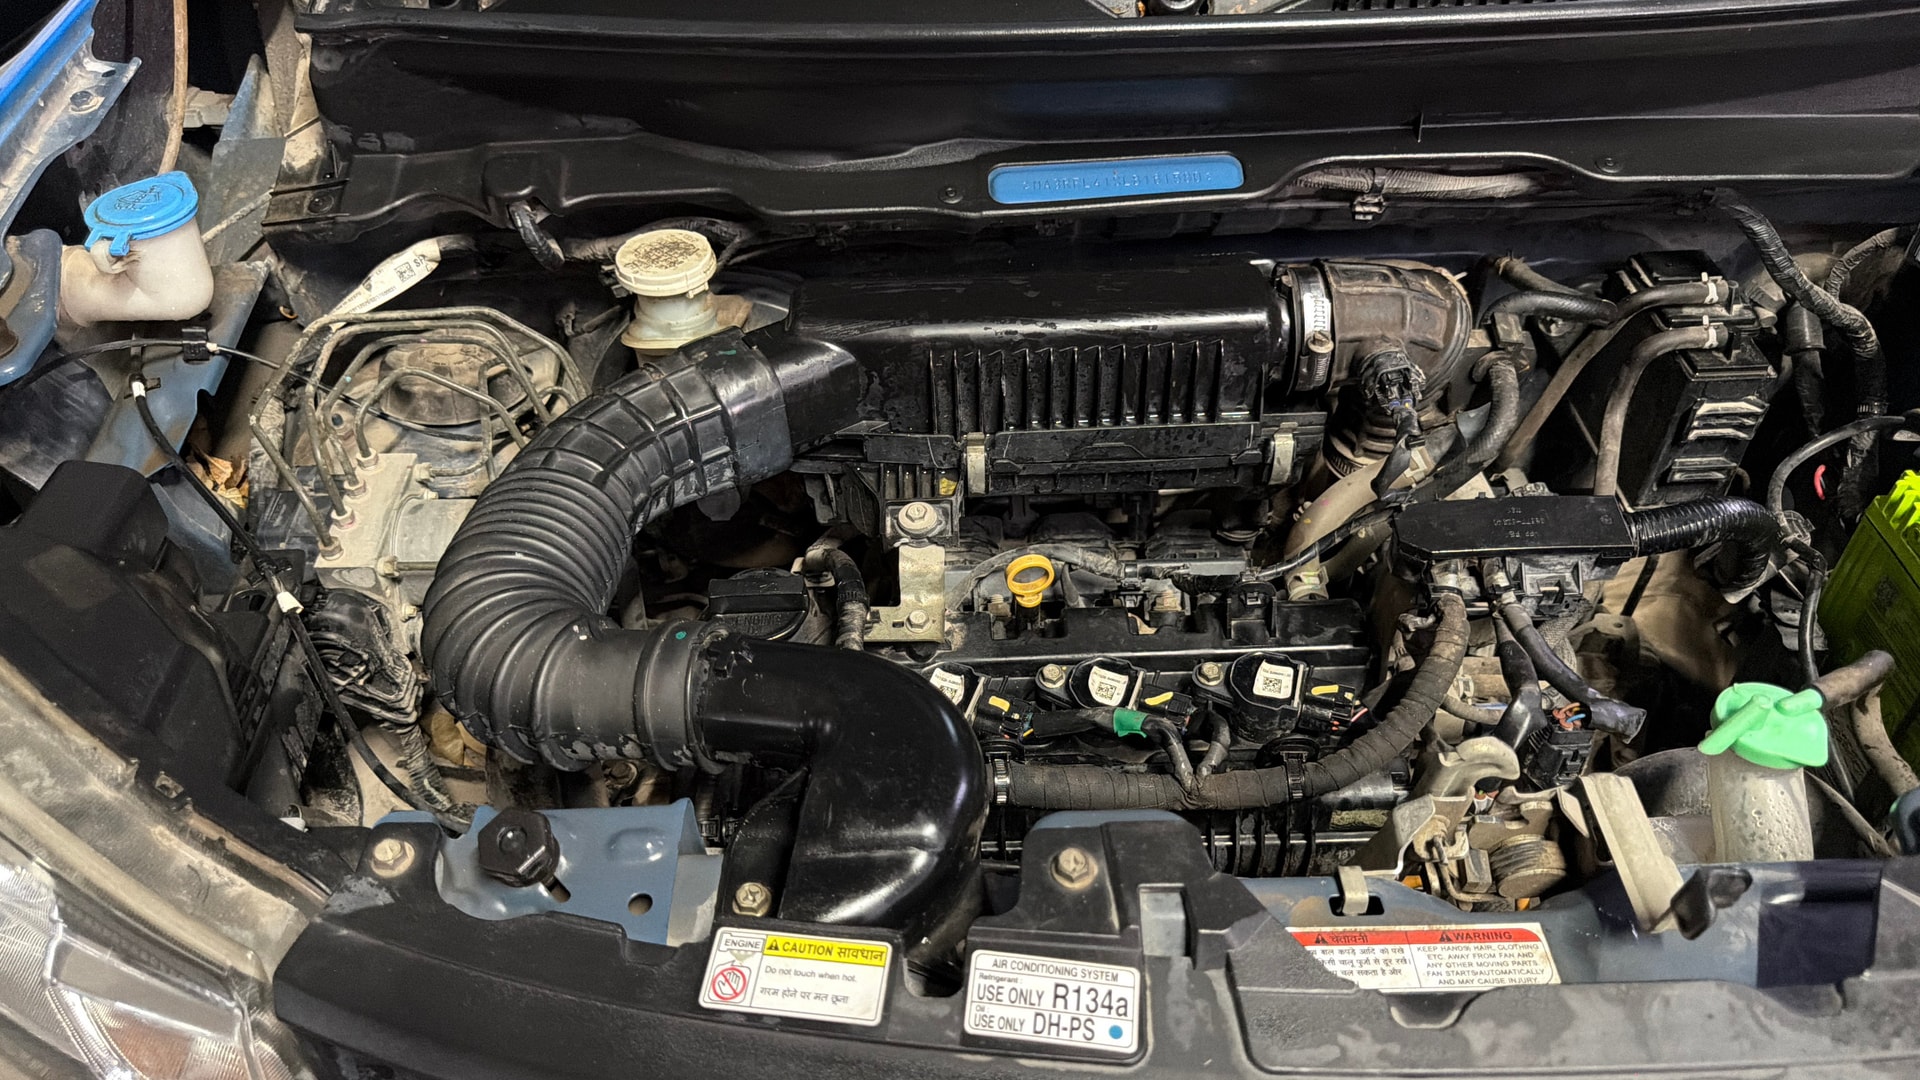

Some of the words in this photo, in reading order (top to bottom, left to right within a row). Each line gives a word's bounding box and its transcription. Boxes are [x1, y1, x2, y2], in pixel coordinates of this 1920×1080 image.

[1453, 931, 1512, 941] WARNING
[724, 939, 760, 949] ENGINE
[782, 942, 833, 956] CAUTION
[1497, 943, 1539, 951] CLOTHING
[837, 946, 885, 961] सावधान
[1473, 952, 1496, 960] FROM
[1518, 951, 1535, 959] AND
[1476, 960, 1509, 968] MOVING
[765, 965, 777, 974] Do
[778, 968, 792, 976] not
[793, 969, 816, 978] touch
[818, 971, 840, 980] when
[992, 958, 1008, 970] AIR
[1010, 960, 1078, 978] CONDITIONING
[1080, 968, 1119, 983] SYSTEM
[979, 972, 1019, 984] Refrigerant
[1477, 977, 1506, 985] CAUSE
[977, 983, 1005, 1003] USE
[1008, 986, 1045, 1007] ONLY
[1052, 982, 1129, 1018] R134a
[975, 1004, 986, 1013] Oil
[974, 1013, 996, 1029] USE
[997, 1016, 1026, 1032] ONLY
[1033, 1011, 1096, 1041] DH-PS
